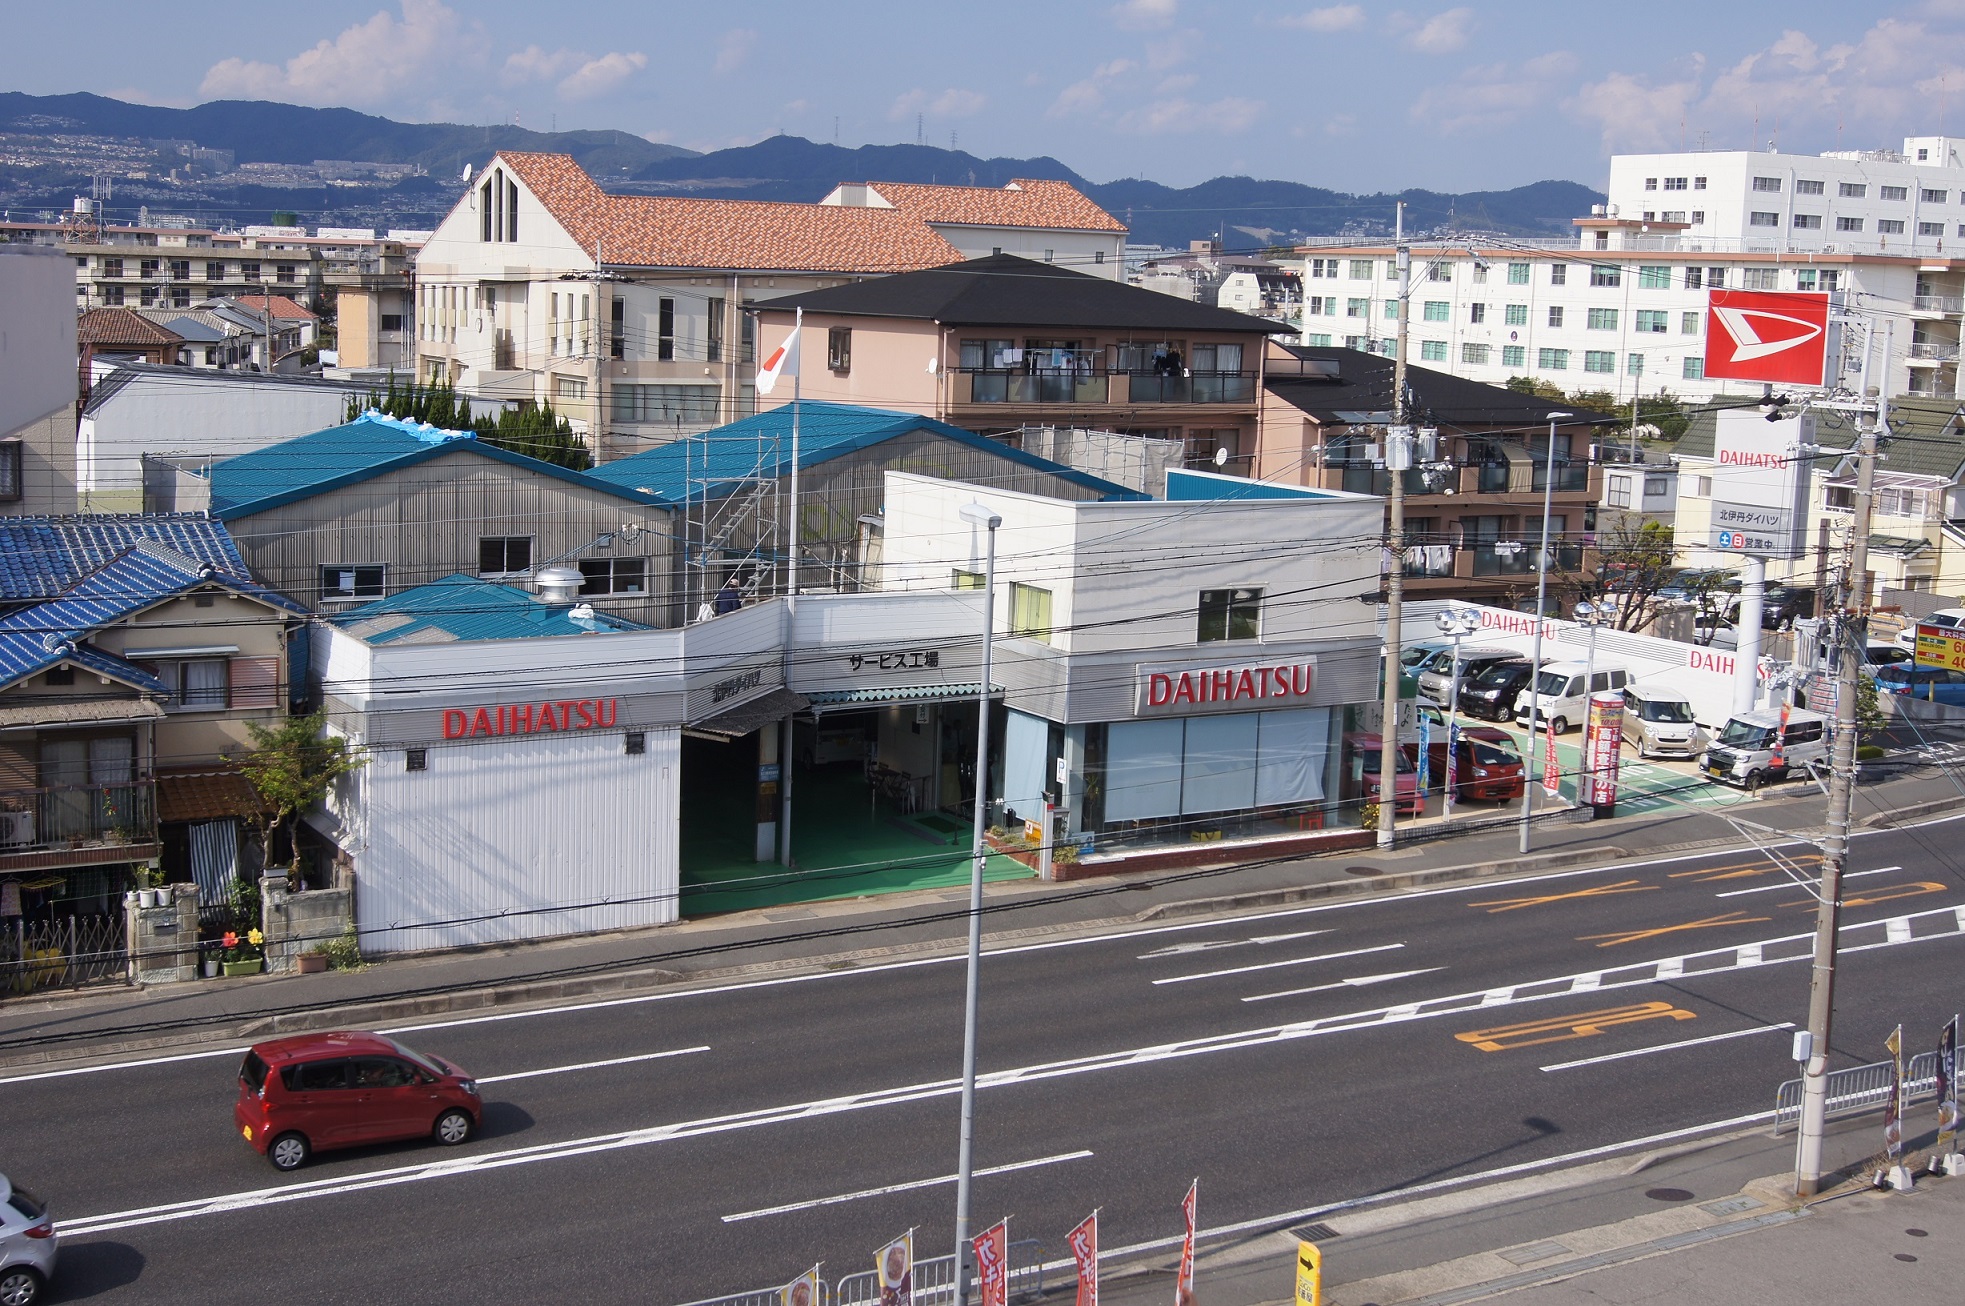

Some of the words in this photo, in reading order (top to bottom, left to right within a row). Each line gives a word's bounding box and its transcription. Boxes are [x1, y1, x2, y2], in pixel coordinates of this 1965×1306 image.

[1720, 450, 1788, 469] DAIHATSU
[1720, 509, 1779, 525] 北伊丹ダイハツ
[850, 651, 939, 671] サービス工場
[1148, 664, 1312, 706] DAIHATSU
[442, 698, 617, 739] DAIHATSU
[1058, 760, 1065, 774] P
[1594, 728, 1613, 803] 高額査定の店
[979, 1238, 998, 1291] カキ
